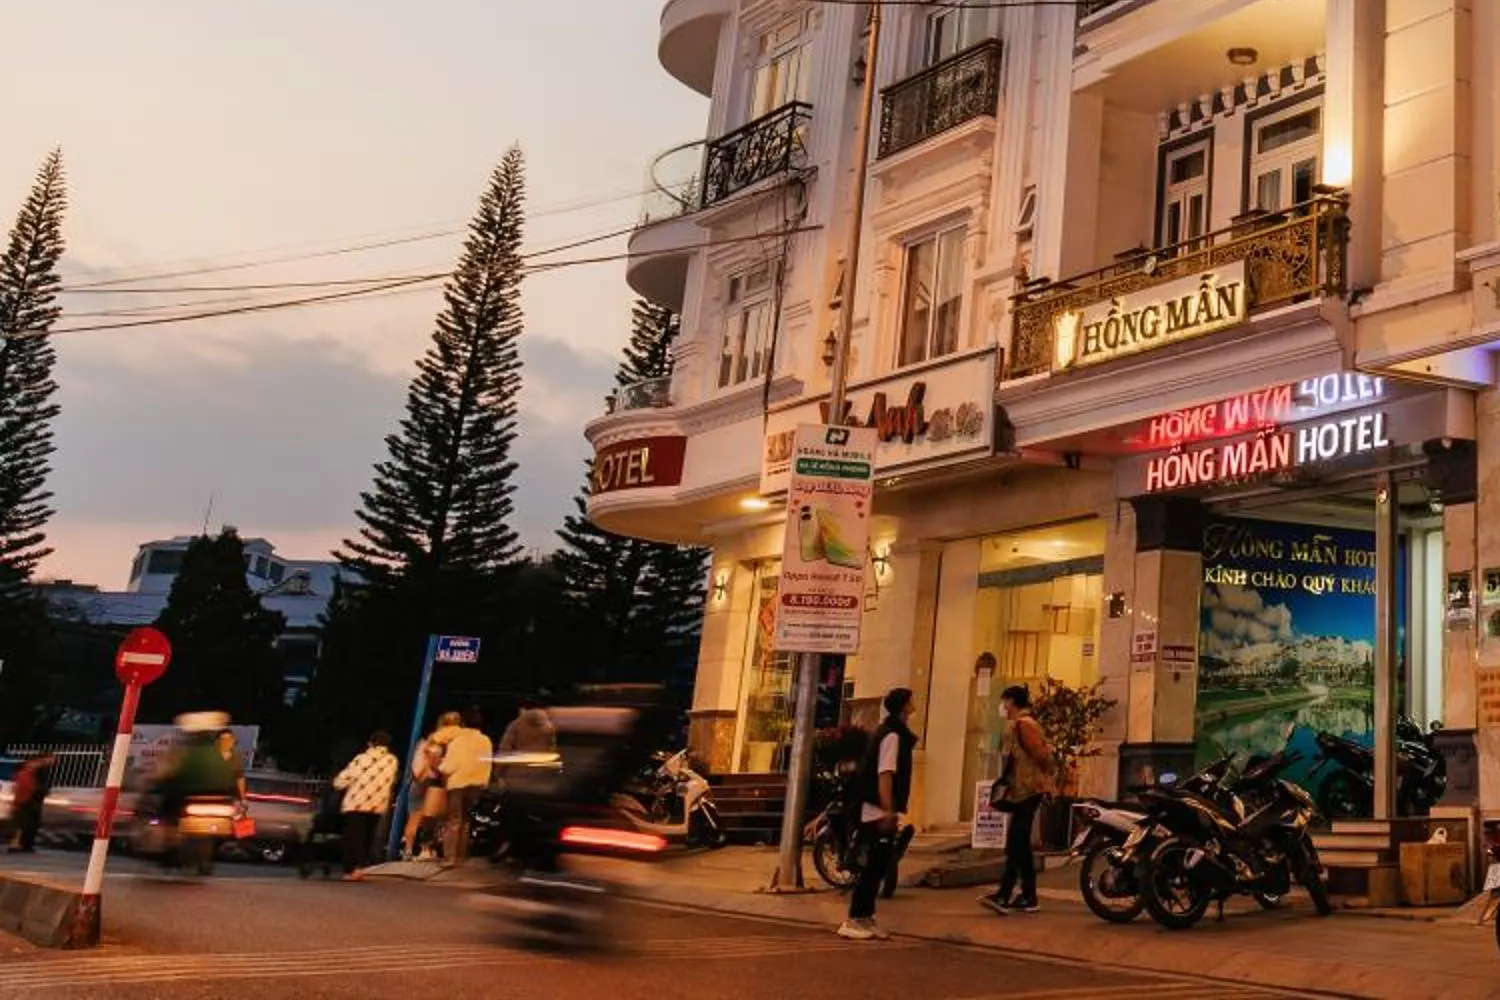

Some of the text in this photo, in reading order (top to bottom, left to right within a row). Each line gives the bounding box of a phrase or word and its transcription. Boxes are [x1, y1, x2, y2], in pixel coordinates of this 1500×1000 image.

[1081, 299, 1162, 356] HỒNG
[1299, 412, 1389, 463] HOTEL
[599, 447, 655, 490] OTEL
[1344, 549, 1378, 569] HOT
